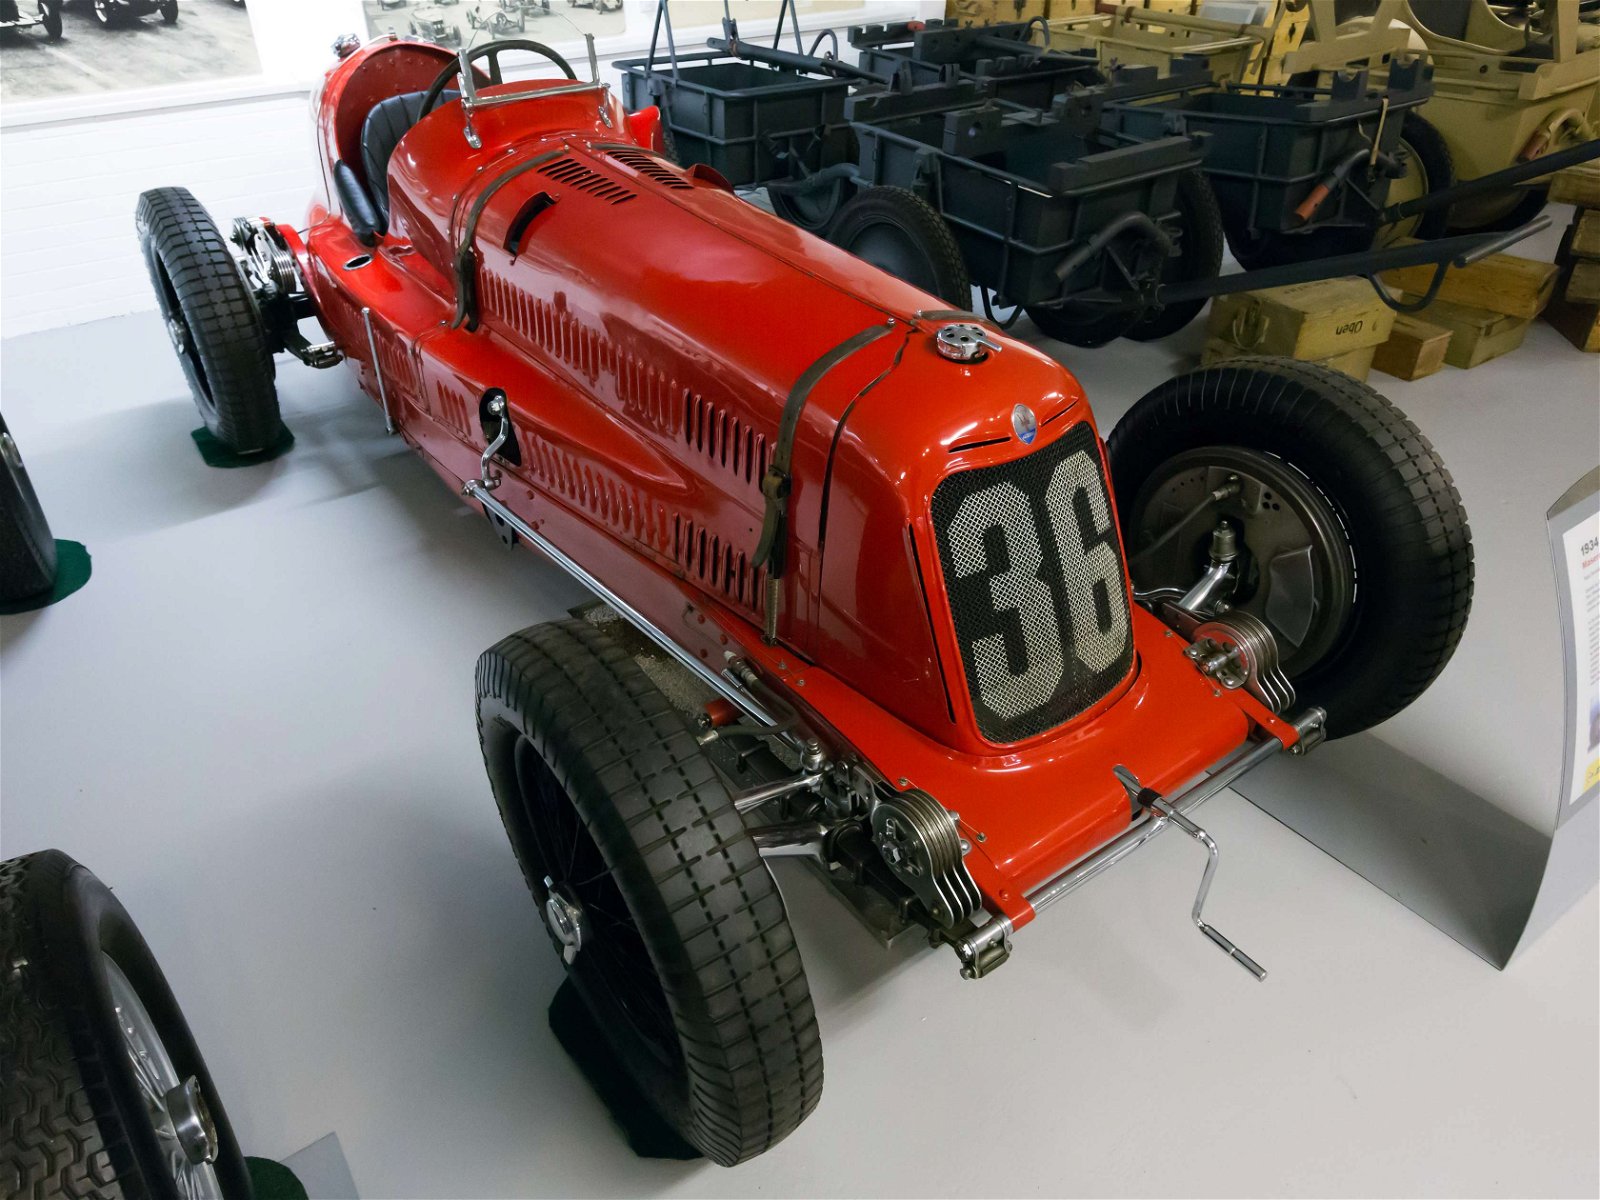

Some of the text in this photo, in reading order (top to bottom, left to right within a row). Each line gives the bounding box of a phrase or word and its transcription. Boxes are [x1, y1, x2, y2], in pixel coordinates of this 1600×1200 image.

[1335, 320, 1363, 335] Oben
[1580, 536, 1599, 556] 1934
[947, 449, 1129, 719] 36
